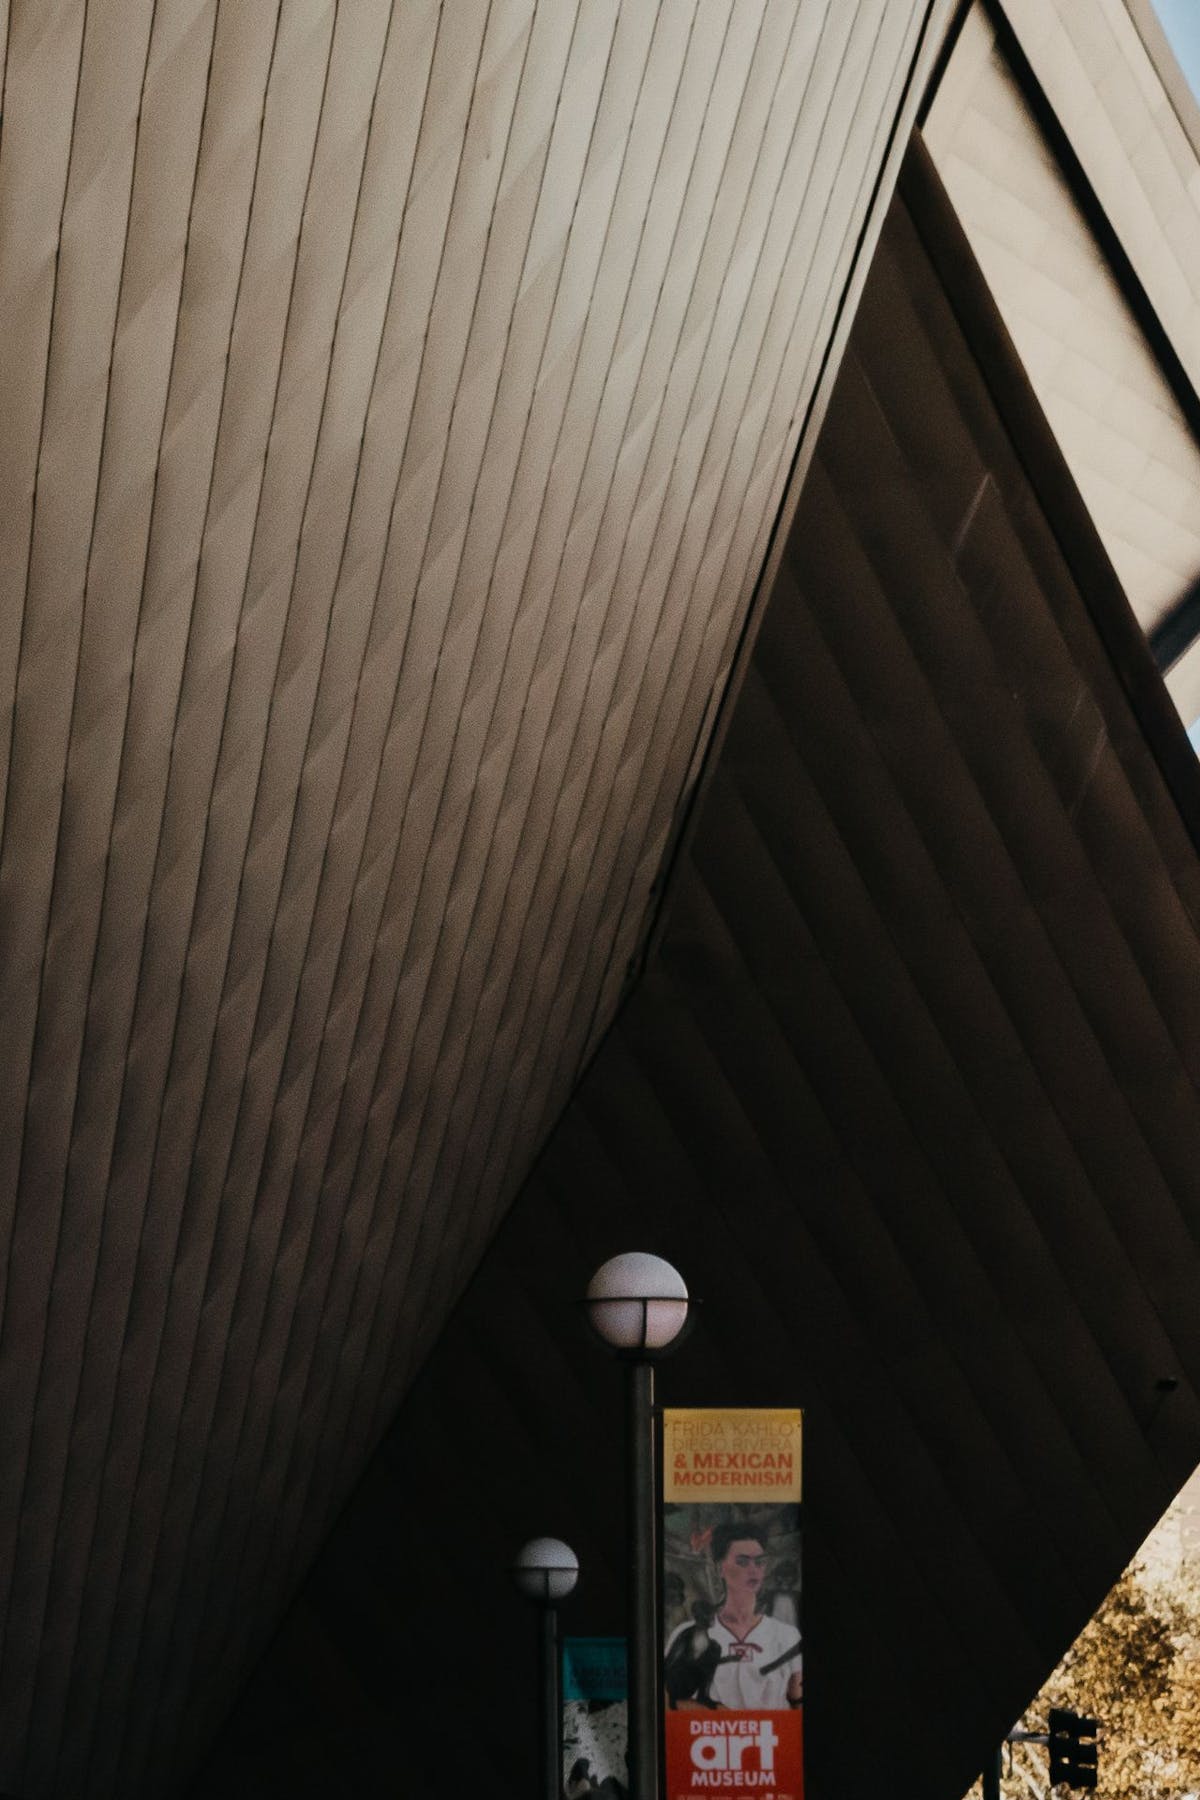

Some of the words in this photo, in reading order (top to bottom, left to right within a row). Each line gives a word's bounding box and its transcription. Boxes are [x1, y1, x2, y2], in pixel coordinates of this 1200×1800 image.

[672, 1420, 725, 1437] FRIDA
[733, 1421, 794, 1437] KAHLO
[673, 1453, 687, 1469] &
[693, 1453, 793, 1469] MEXICAN
[673, 1471, 794, 1487] MODERNISM
[690, 1720, 760, 1735] DENVER
[690, 1720, 779, 1770] art
[691, 1771, 776, 1787] MUSEUM
